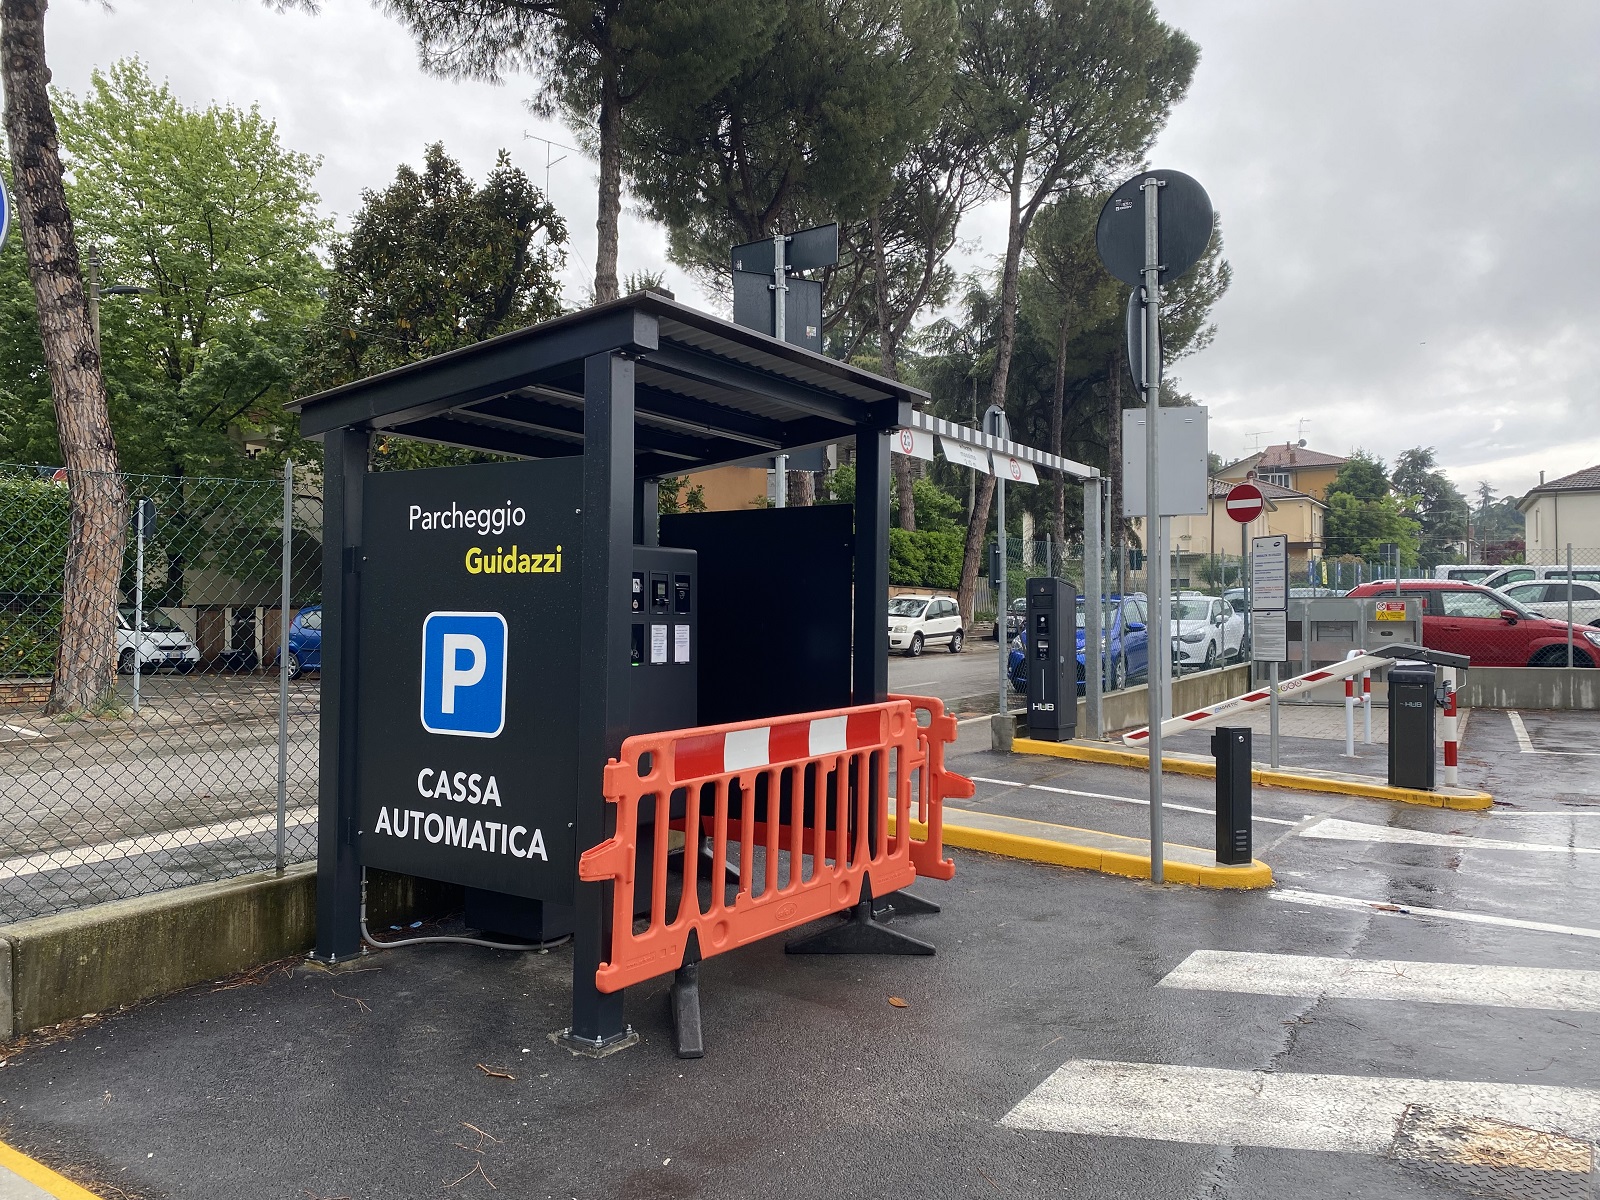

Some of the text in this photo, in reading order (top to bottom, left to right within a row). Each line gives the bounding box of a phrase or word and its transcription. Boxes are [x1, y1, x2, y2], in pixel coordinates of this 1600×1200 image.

[409, 499, 526, 536] Parcheggio
[465, 544, 563, 575] Guidazzi
[441, 633, 487, 715] P
[1032, 702, 1055, 712] HUB
[417, 767, 502, 807] CASSA
[374, 806, 549, 862] AUTOMATICA
